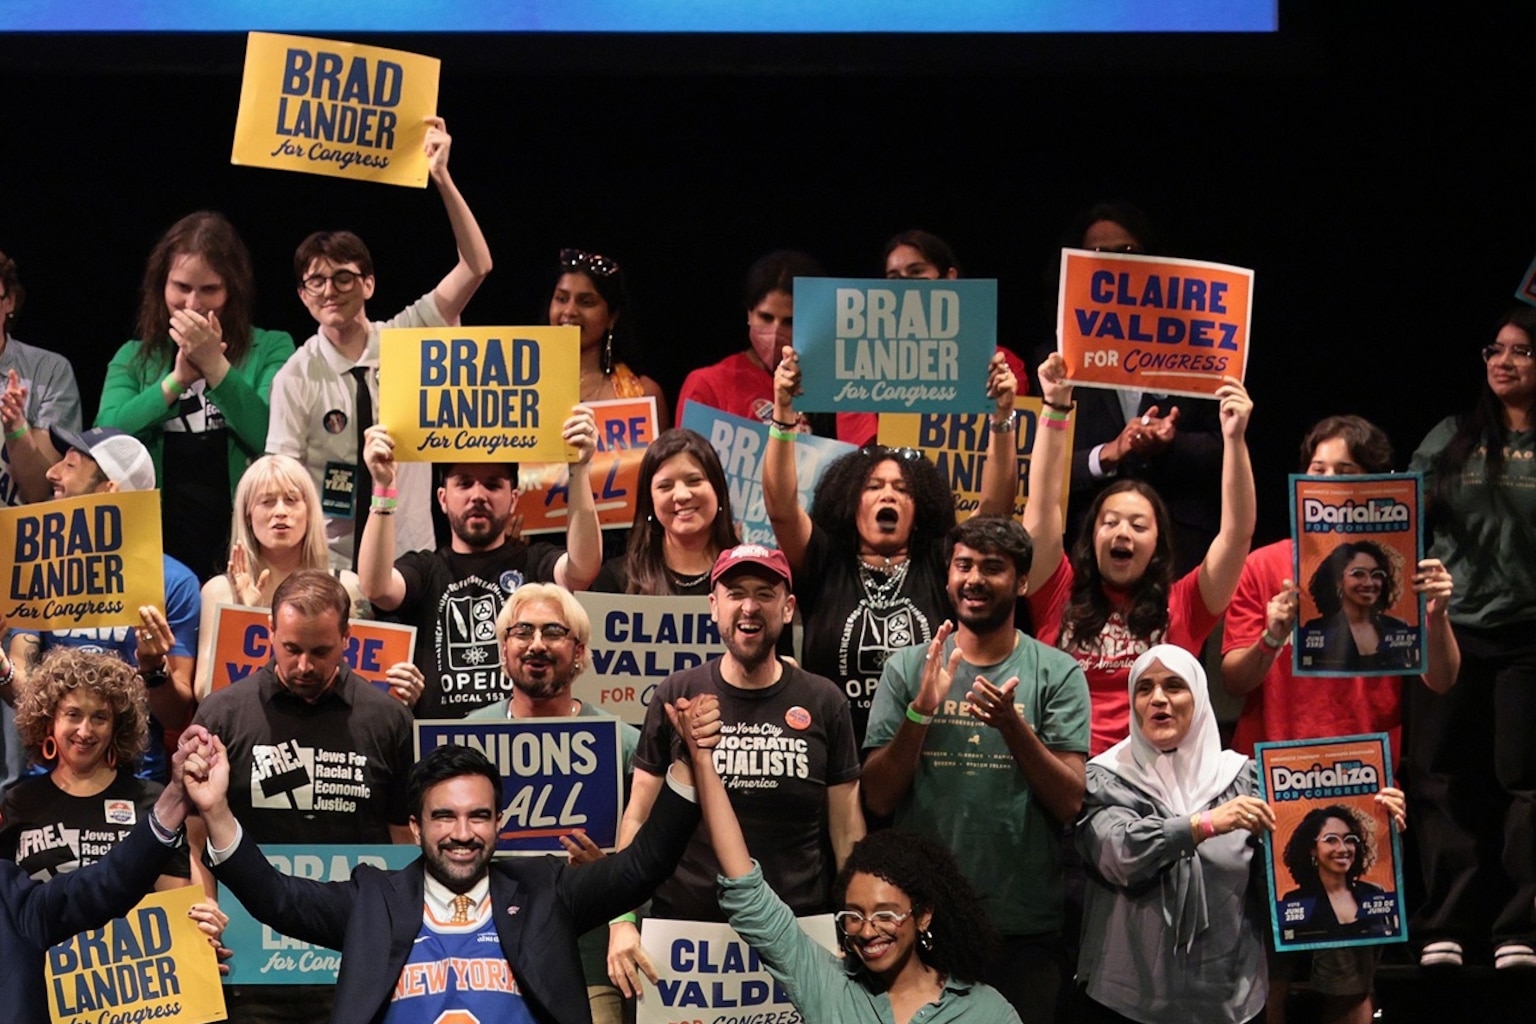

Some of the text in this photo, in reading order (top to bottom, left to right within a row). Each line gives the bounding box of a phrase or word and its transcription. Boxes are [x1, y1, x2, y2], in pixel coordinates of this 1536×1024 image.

[282, 48, 403, 107] BRAD
[275, 97, 397, 150] LANDER
[271, 139, 390, 169] for Congress
[1090, 270, 1228, 314] CLAIRE
[836, 288, 959, 339] BRAD
[1075, 309, 1238, 351] VALDEZ
[419, 339, 540, 386] BRAD
[835, 340, 958, 382] LANDER
[1083, 349, 1229, 373] FOR CONGRESS
[833, 382, 957, 407] for Congress
[419, 389, 539, 429] LANDER
[417, 431, 538, 454] for Congress
[1304, 500, 1408, 523] Darializa
[14, 505, 123, 563] BRAD
[1305, 522, 1409, 532] FOR CONGRESS
[10, 555, 124, 601] LANDER
[6, 599, 124, 621] for Congress
[605, 610, 721, 645] CLAIR
[441, 671, 514, 692] OPEIU
[600, 687, 636, 704] FOR
[449, 692, 504, 704] LOCAL 153
[315, 749, 367, 768] Jews For
[712, 749, 810, 779] CIALISTS
[315, 764, 363, 782] Racial &
[1272, 763, 1377, 791] Darializa
[314, 783, 371, 799] Economic
[314, 797, 356, 813] Justice
[501, 782, 587, 828] ALL
[1275, 785, 1378, 800] FOR CONGRESS
[81, 830, 115, 842] Jews
[49, 906, 173, 976] BRAD
[260, 951, 297, 974] for
[53, 956, 181, 1018] LANDER
